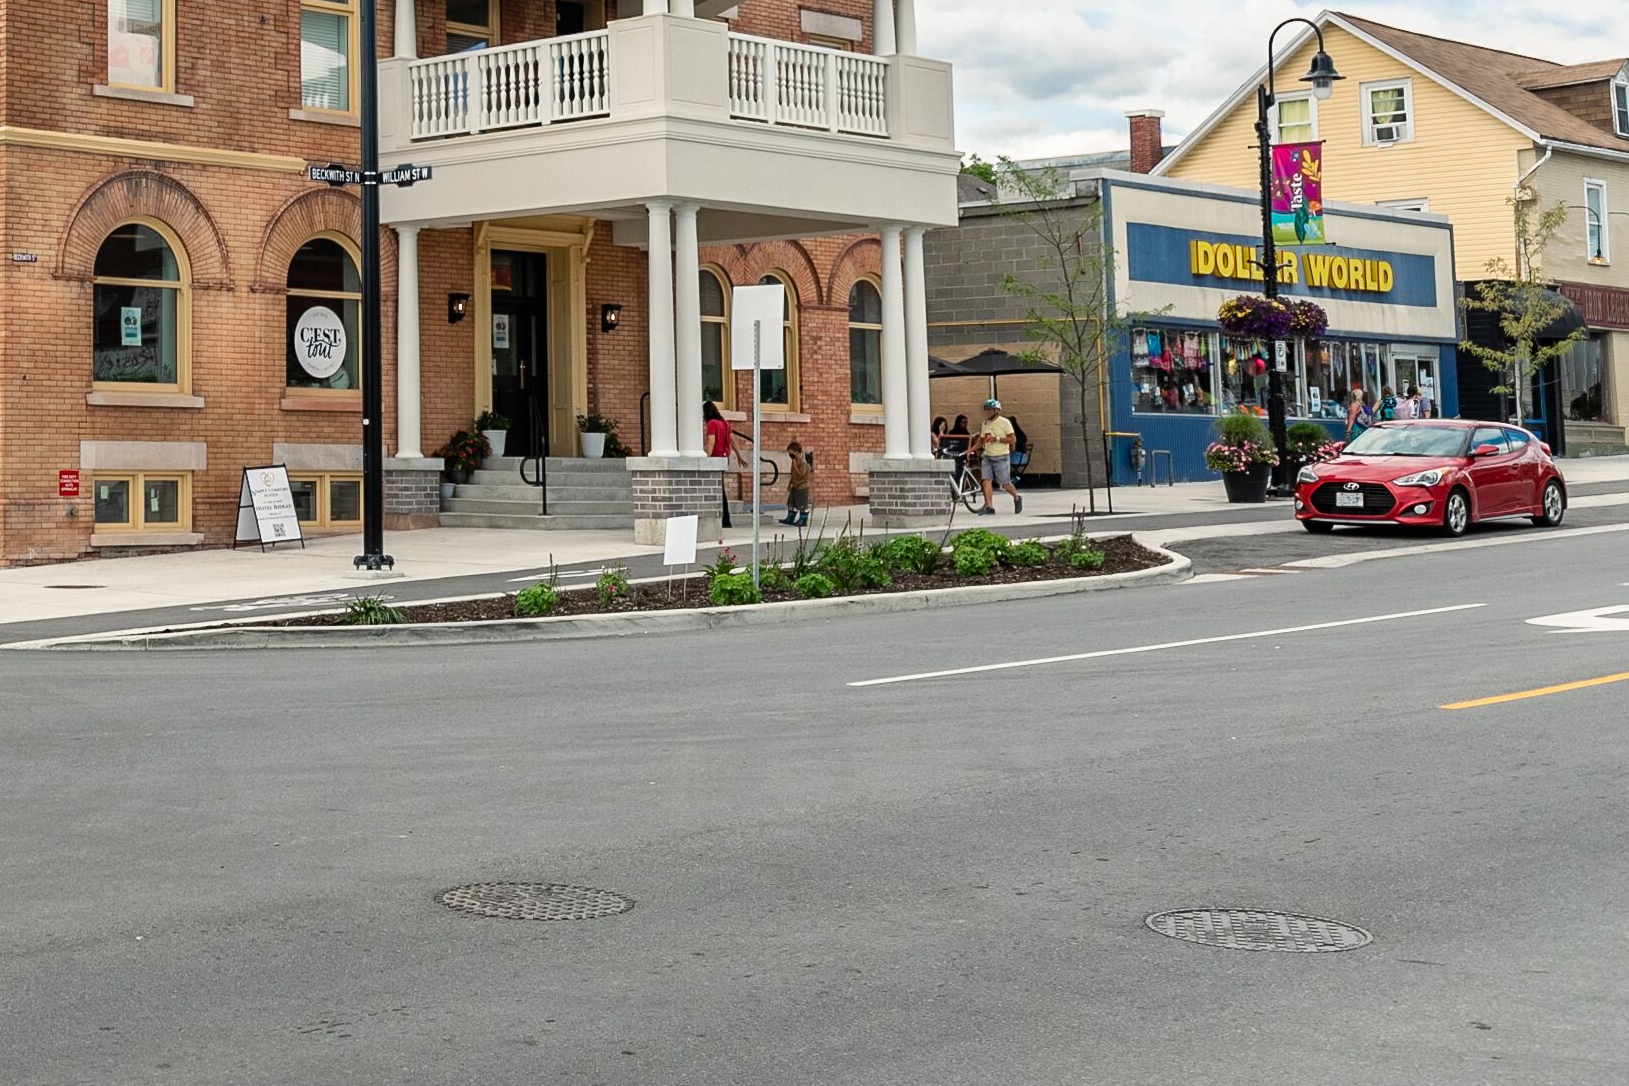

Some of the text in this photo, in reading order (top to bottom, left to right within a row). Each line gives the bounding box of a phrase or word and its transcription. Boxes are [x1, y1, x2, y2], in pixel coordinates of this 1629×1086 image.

[312, 168, 360, 183] BECKWITH ST N
[382, 167, 428, 183] WILLIAM ST W
[1291, 172, 1303, 212] Taste
[1301, 253, 1394, 292] WORLD
